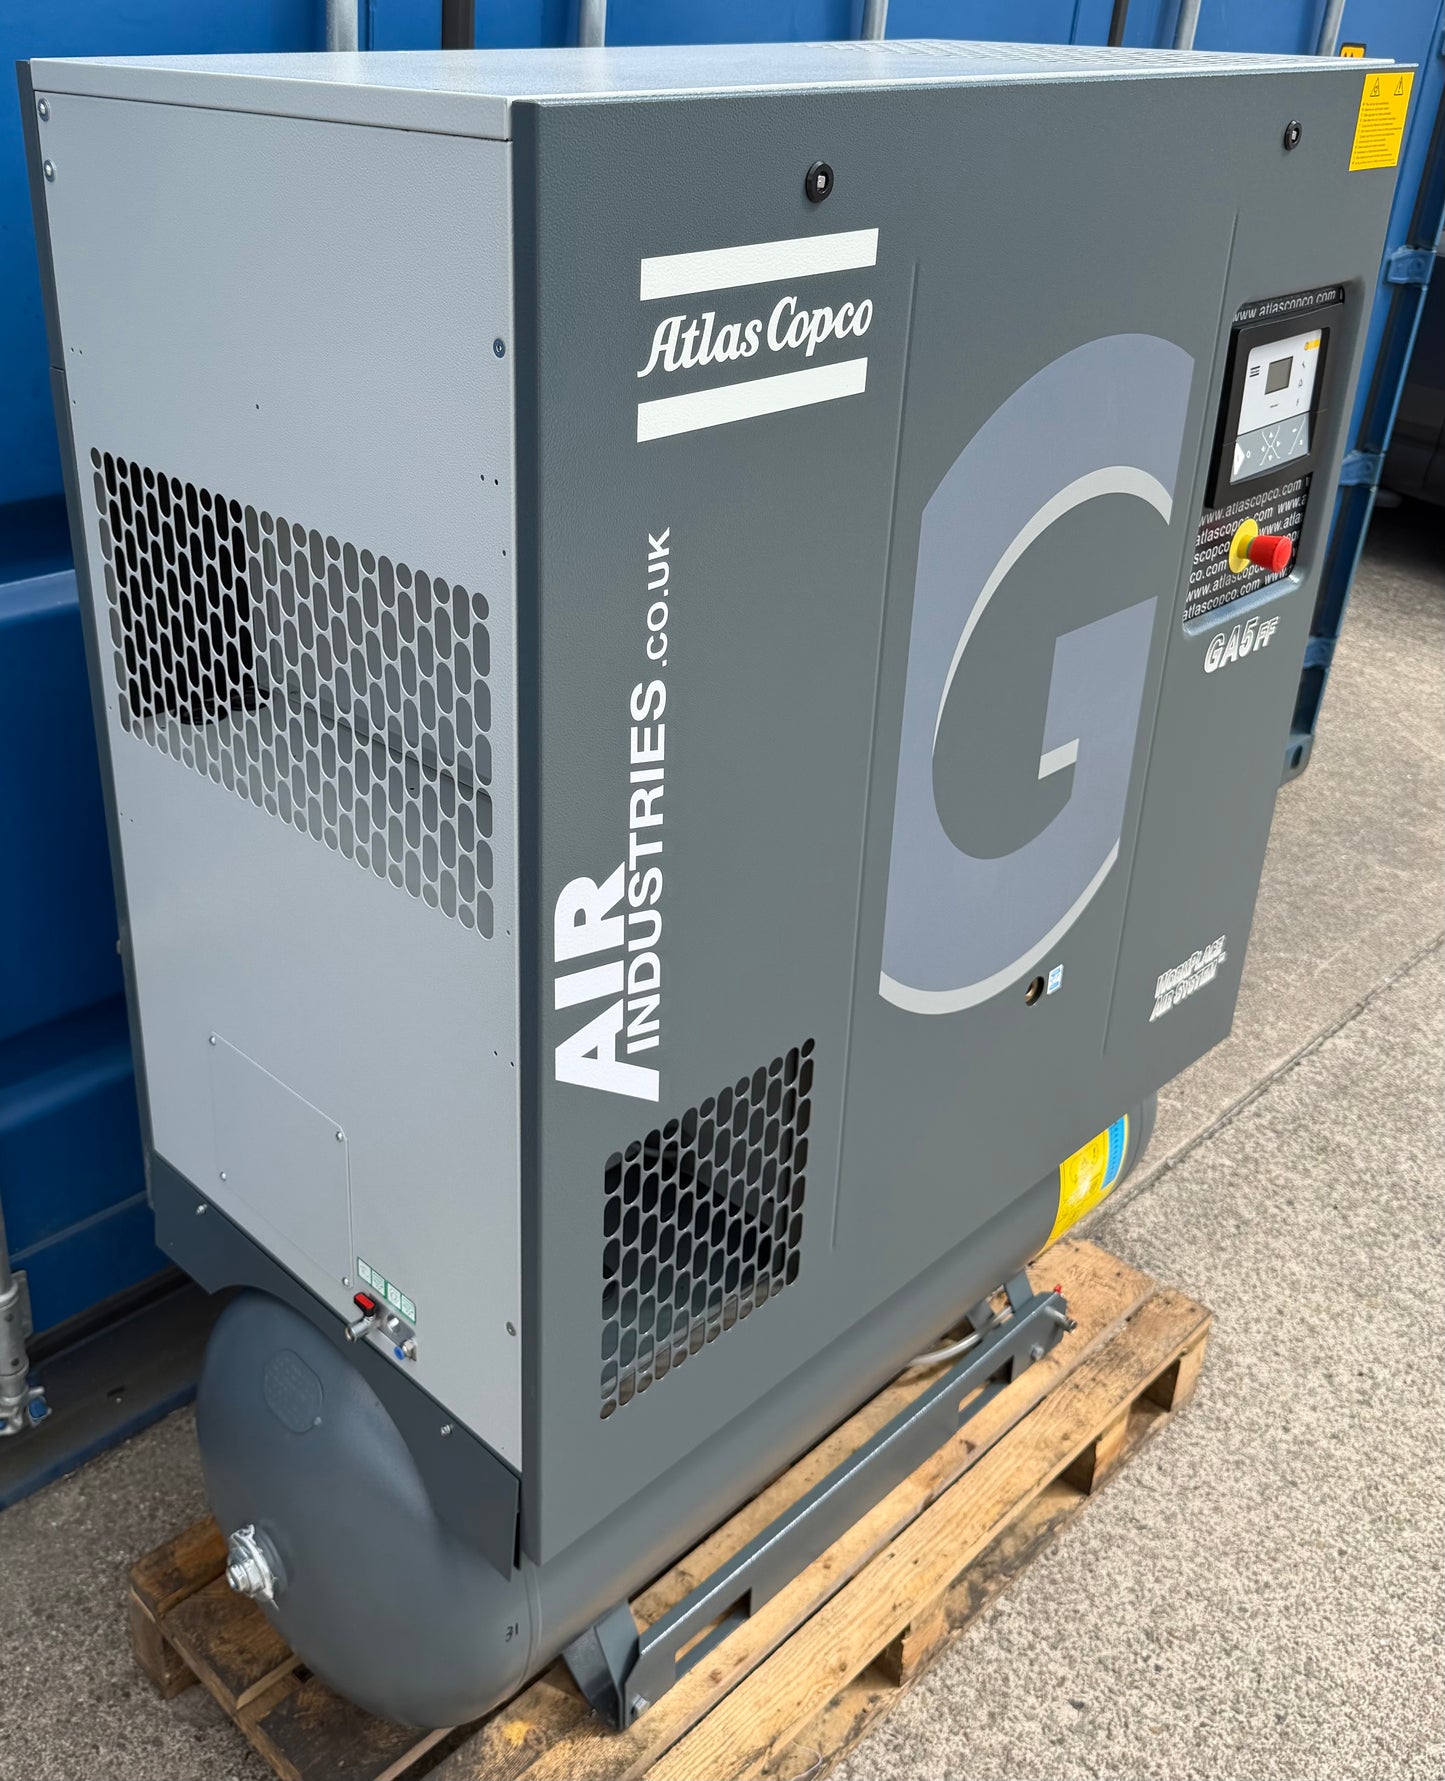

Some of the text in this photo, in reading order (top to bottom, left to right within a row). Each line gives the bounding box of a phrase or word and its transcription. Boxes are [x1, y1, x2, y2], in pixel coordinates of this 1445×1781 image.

[637, 295, 874, 378] Atlas Copco
[1258, 511, 1303, 537] www.atla
[626, 526, 671, 1054] INDUSTRIES .CO.UK
[553, 860, 660, 1103] AIR
